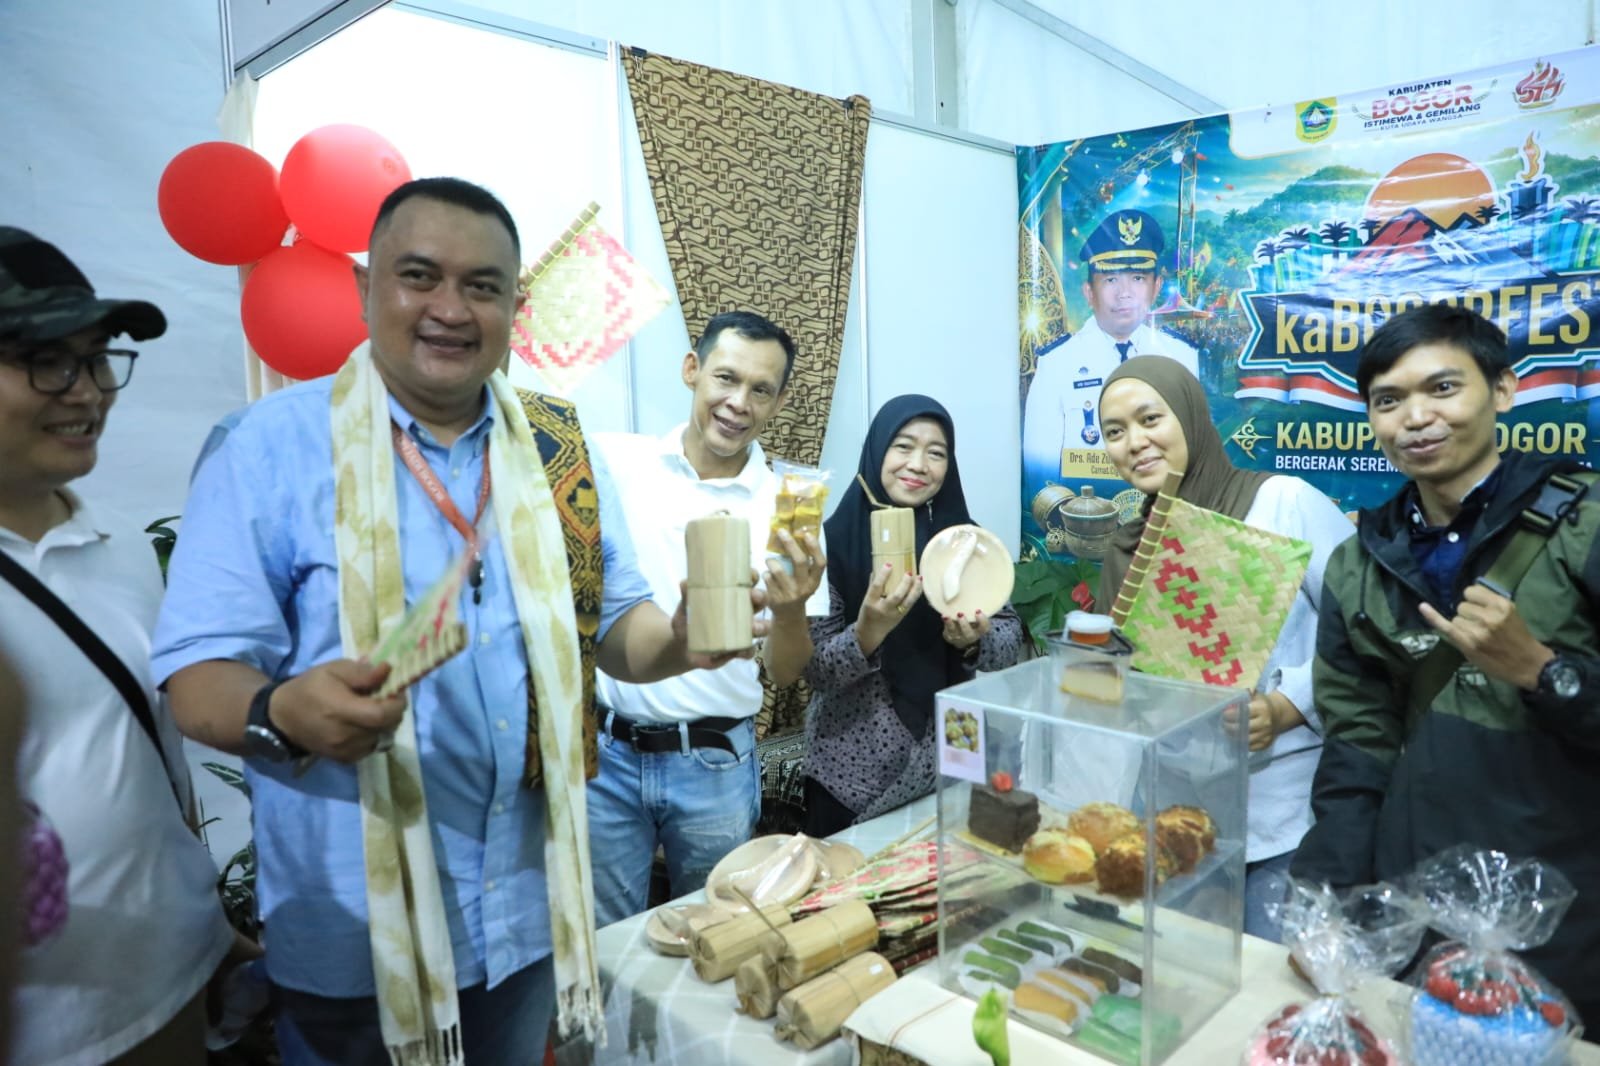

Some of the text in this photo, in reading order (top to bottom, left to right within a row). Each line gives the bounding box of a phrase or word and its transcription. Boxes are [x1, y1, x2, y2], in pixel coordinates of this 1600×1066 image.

[1388, 79, 1452, 96] KABUPATEN
[1372, 84, 1473, 119] BOGOR
[1364, 115, 1413, 128] ISTIMEWA
[1425, 103, 1481, 118] GEMILANG
[1276, 421, 1587, 454] KABUP OGOR
[1275, 455, 1347, 471] BERGERAK
